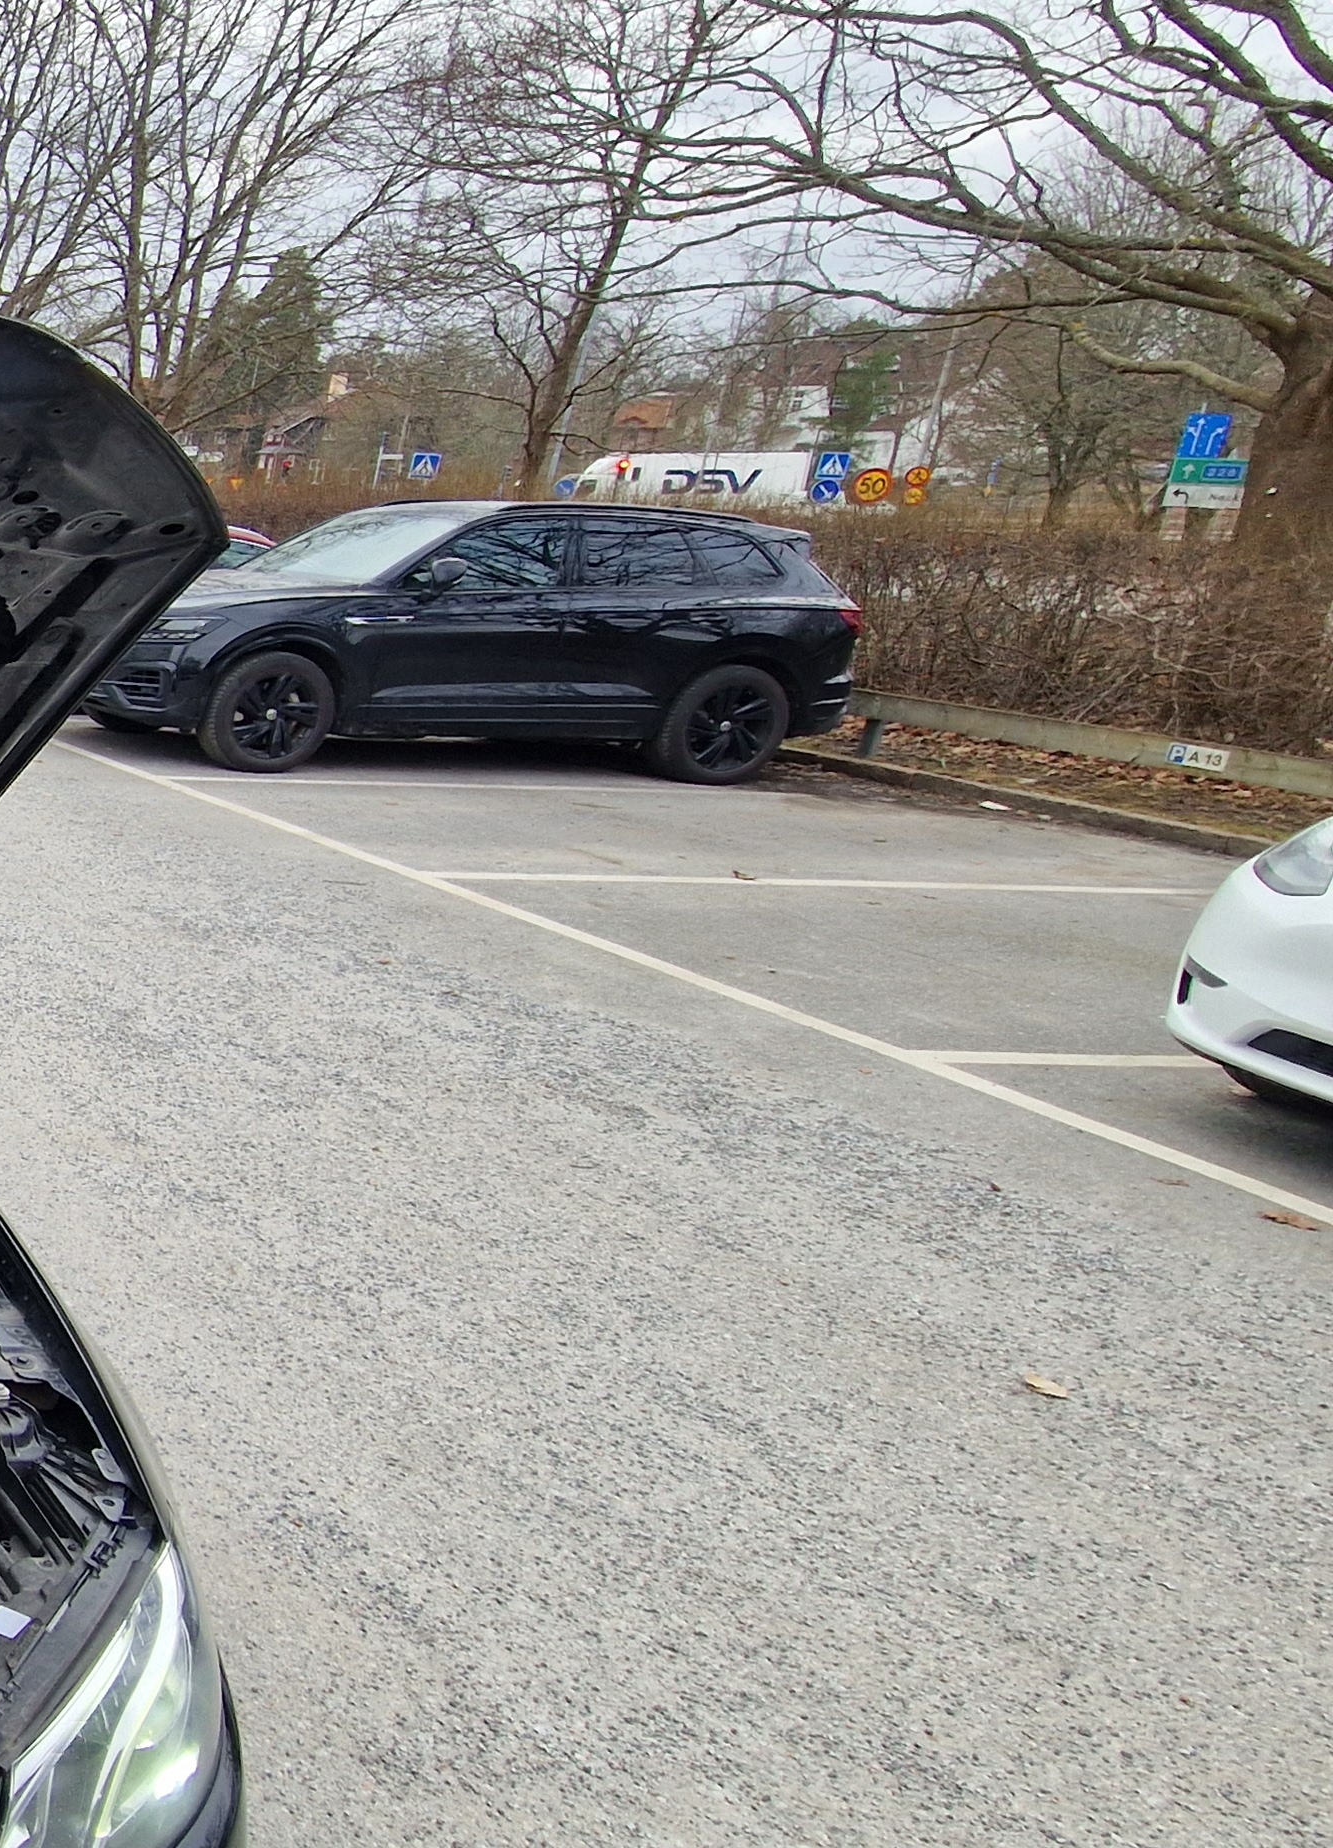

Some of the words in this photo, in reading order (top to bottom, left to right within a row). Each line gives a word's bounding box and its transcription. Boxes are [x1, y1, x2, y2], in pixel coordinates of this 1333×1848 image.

[661, 469, 763, 494] DSV
[858, 477, 886, 494] 50
[1170, 745, 1185, 761] P
[1188, 751, 1199, 763] A
[1206, 753, 1222, 766] 13
